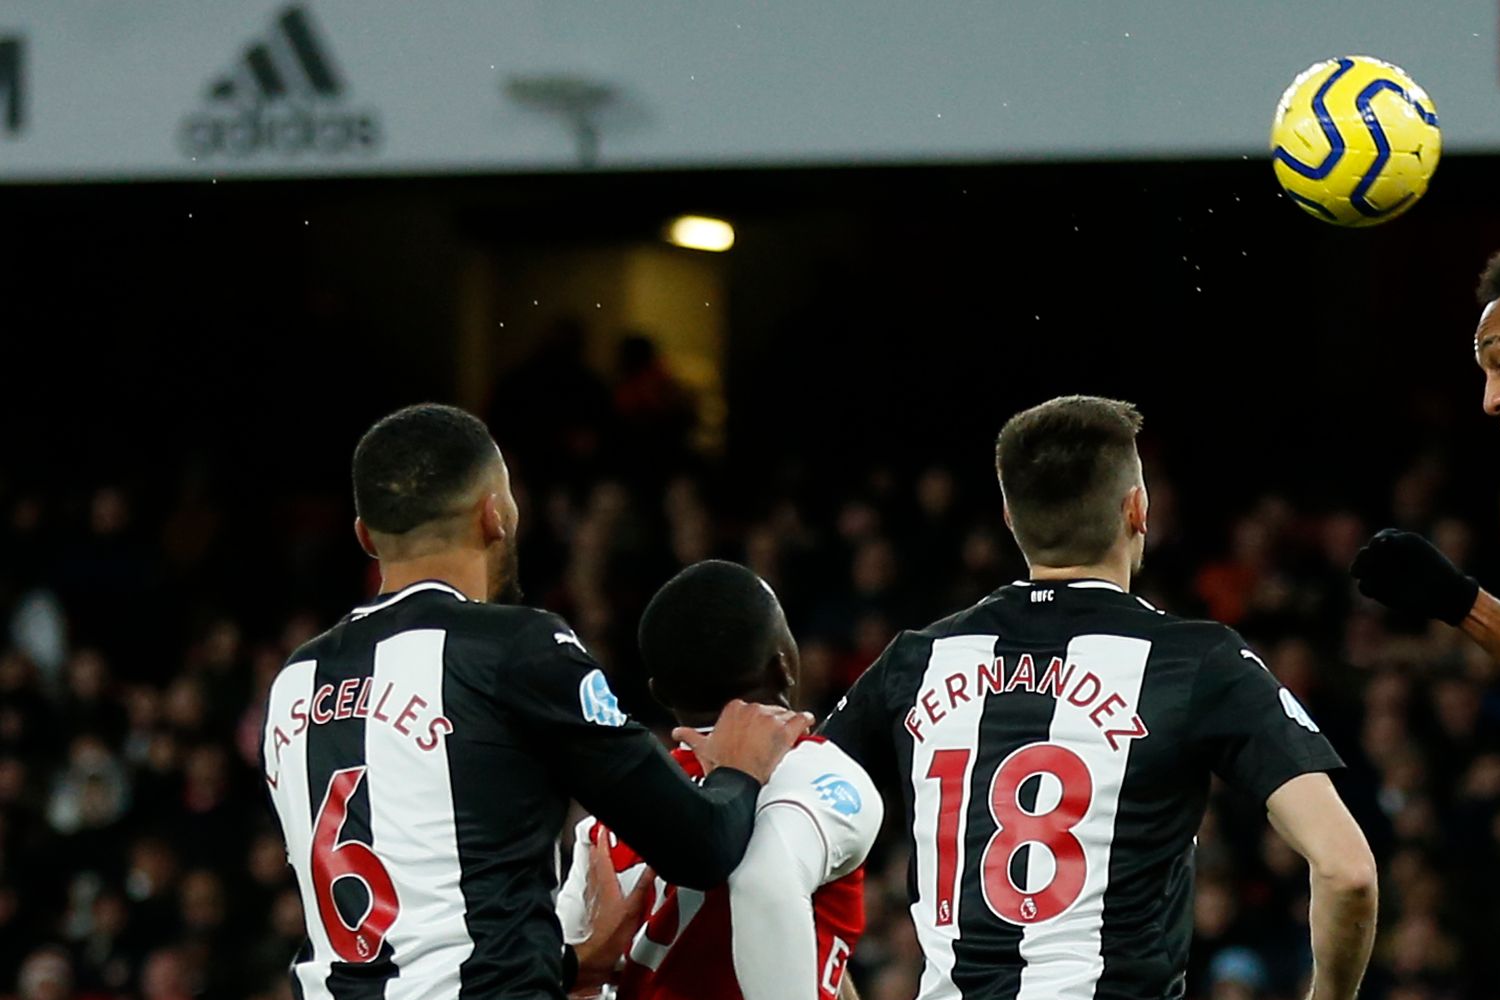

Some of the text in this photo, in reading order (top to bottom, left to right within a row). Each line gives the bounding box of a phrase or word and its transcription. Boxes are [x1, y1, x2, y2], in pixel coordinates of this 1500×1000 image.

[180, 104, 383, 156] adidas
[265, 677, 454, 790] LASCELLES
[904, 654, 1149, 752] FERNANDEZ
[310, 765, 400, 964] 6
[926, 742, 1094, 928] 18
